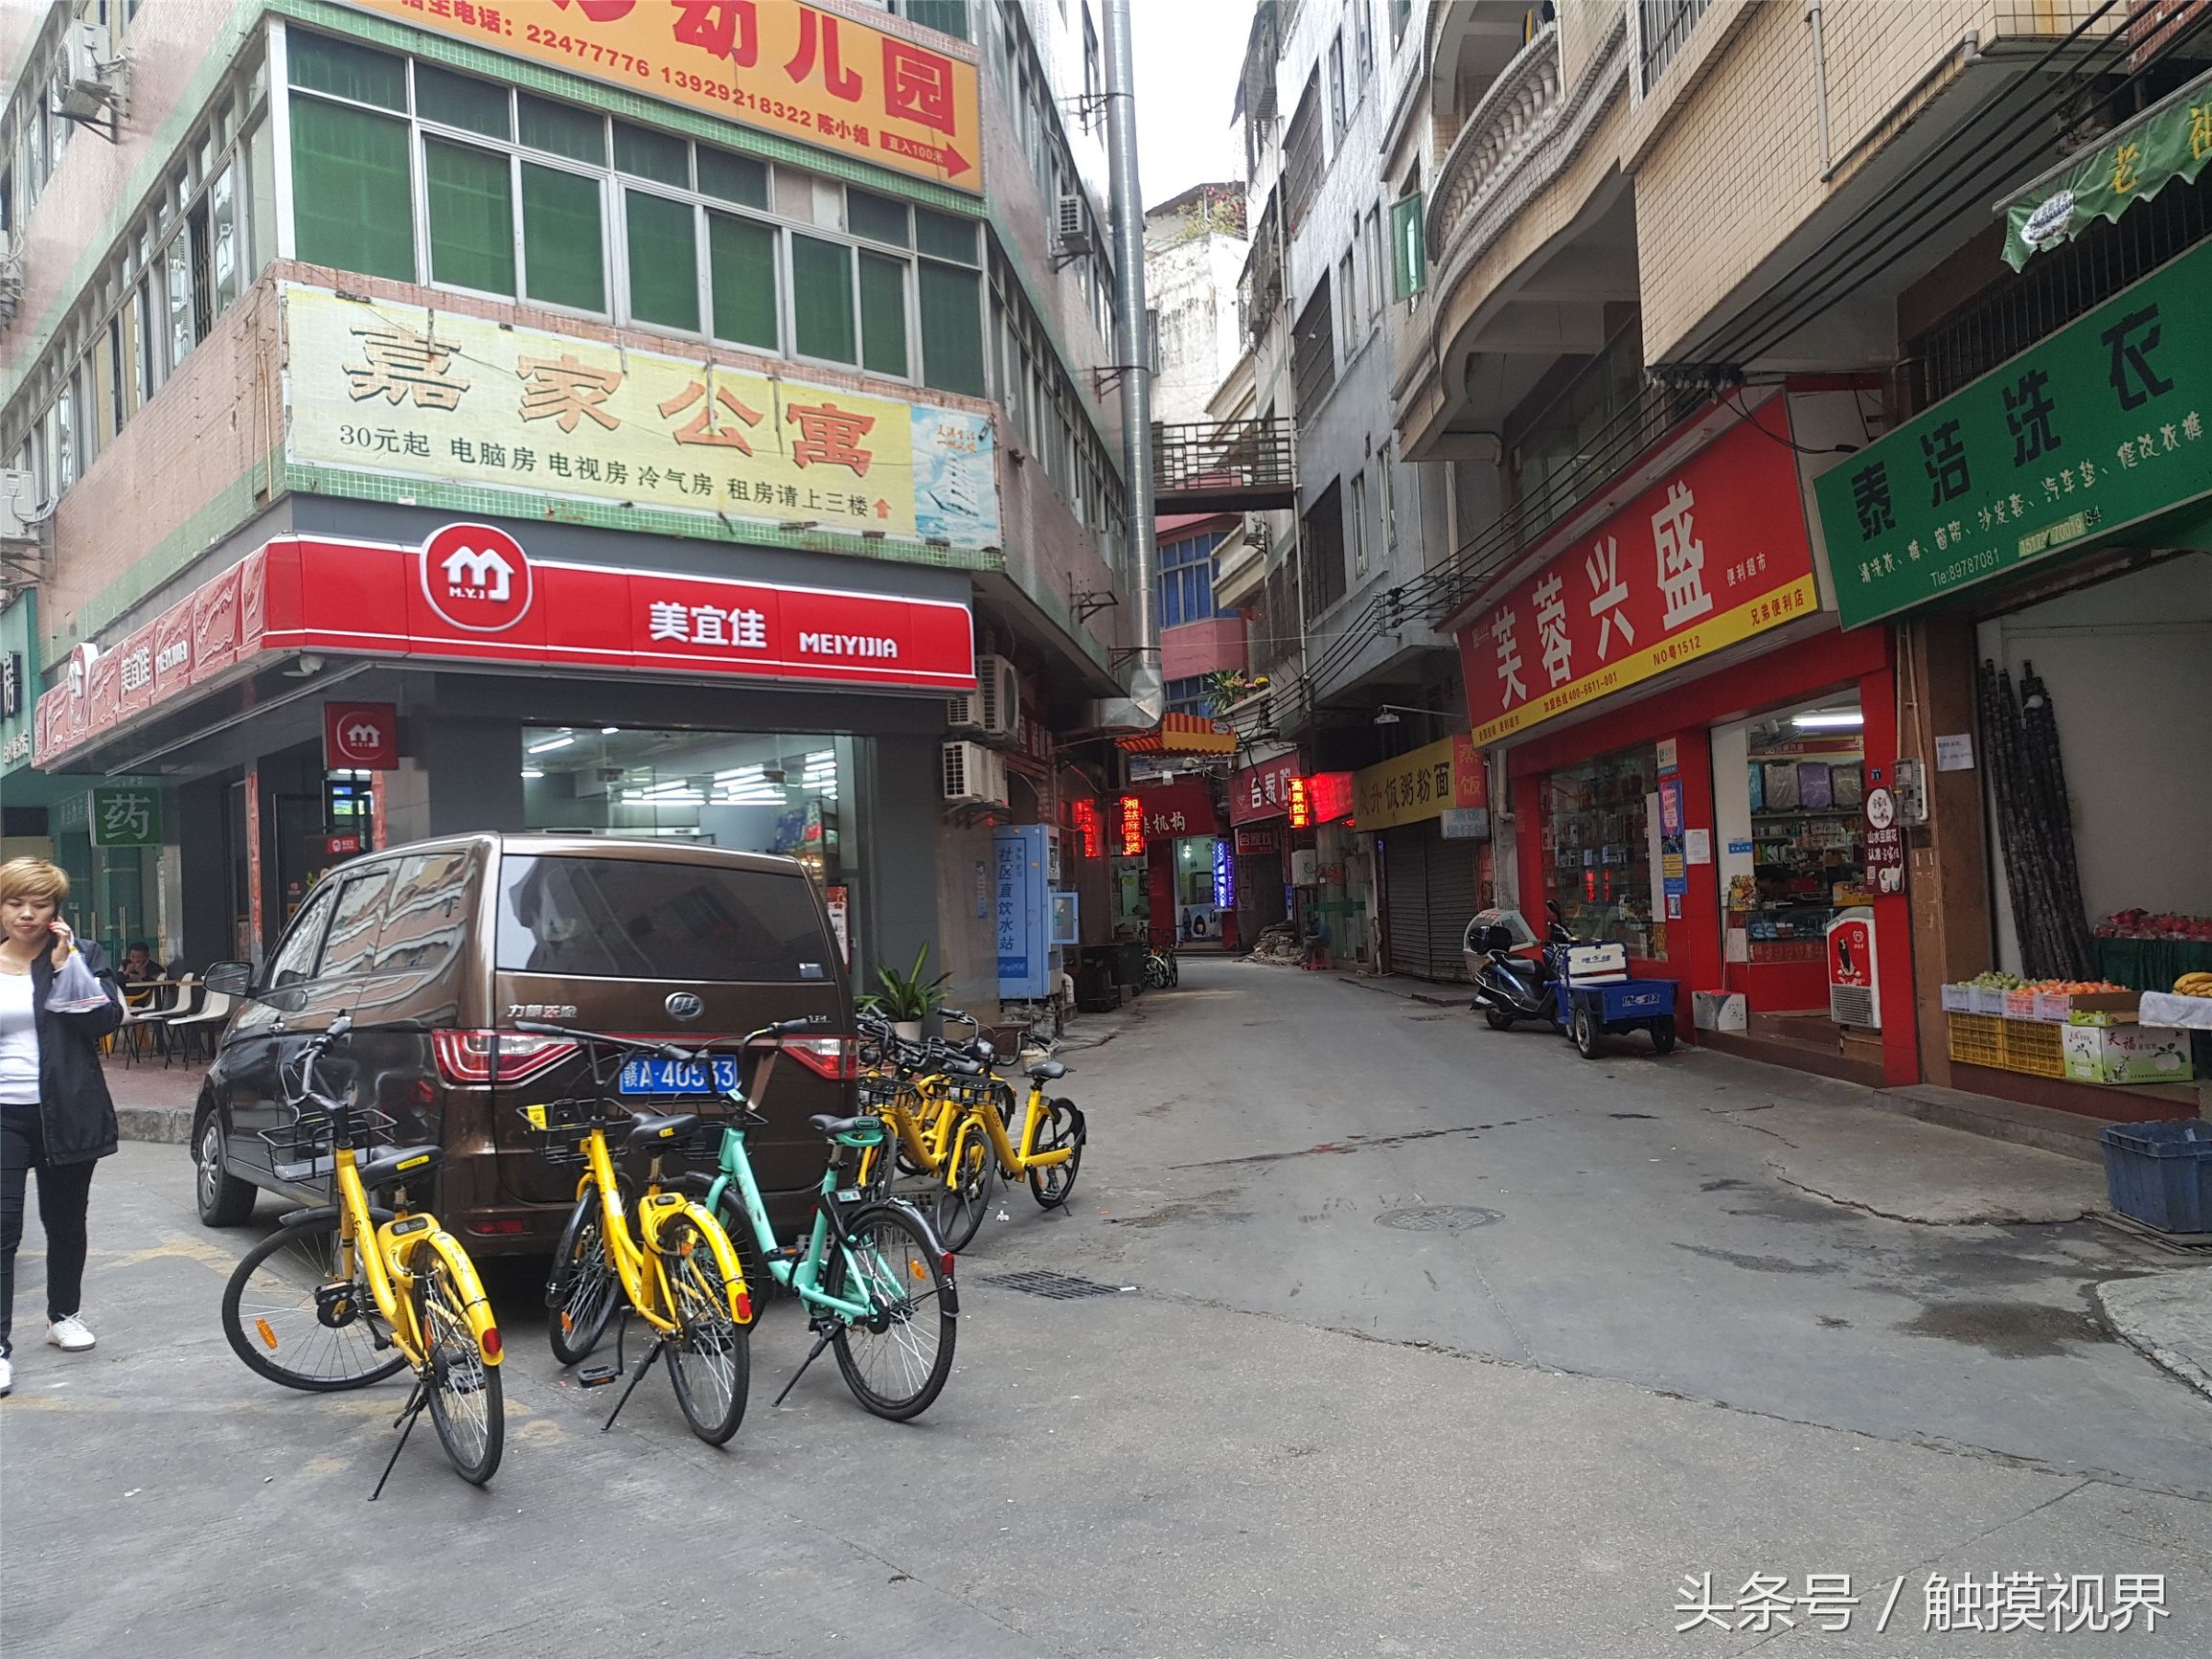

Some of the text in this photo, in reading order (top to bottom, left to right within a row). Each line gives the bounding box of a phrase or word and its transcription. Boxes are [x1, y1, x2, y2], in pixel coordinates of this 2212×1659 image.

[551, 0, 956, 137] 幼儿园
[661, 67, 811, 127] 13929218322
[817, 113, 870, 147] 陈小姐
[888, 136, 944, 165] 直入100米
[342, 323, 876, 477] 嘉家公寓
[1851, 302, 2175, 542] 泰洁洗衣
[339, 424, 869, 517] 30元起 电脑房 电视房 冷气房 租房请上三楼
[1491, 479, 1714, 711] 芙蓉兴盛
[1726, 552, 1767, 587] 便利超市
[1750, 588, 1805, 626] 兄弟便利店
[649, 601, 898, 659] 美宜佳 MEIYIJIA
[103, 793, 152, 840] 药
[998, 846, 1015, 951] 社区直饮水站
